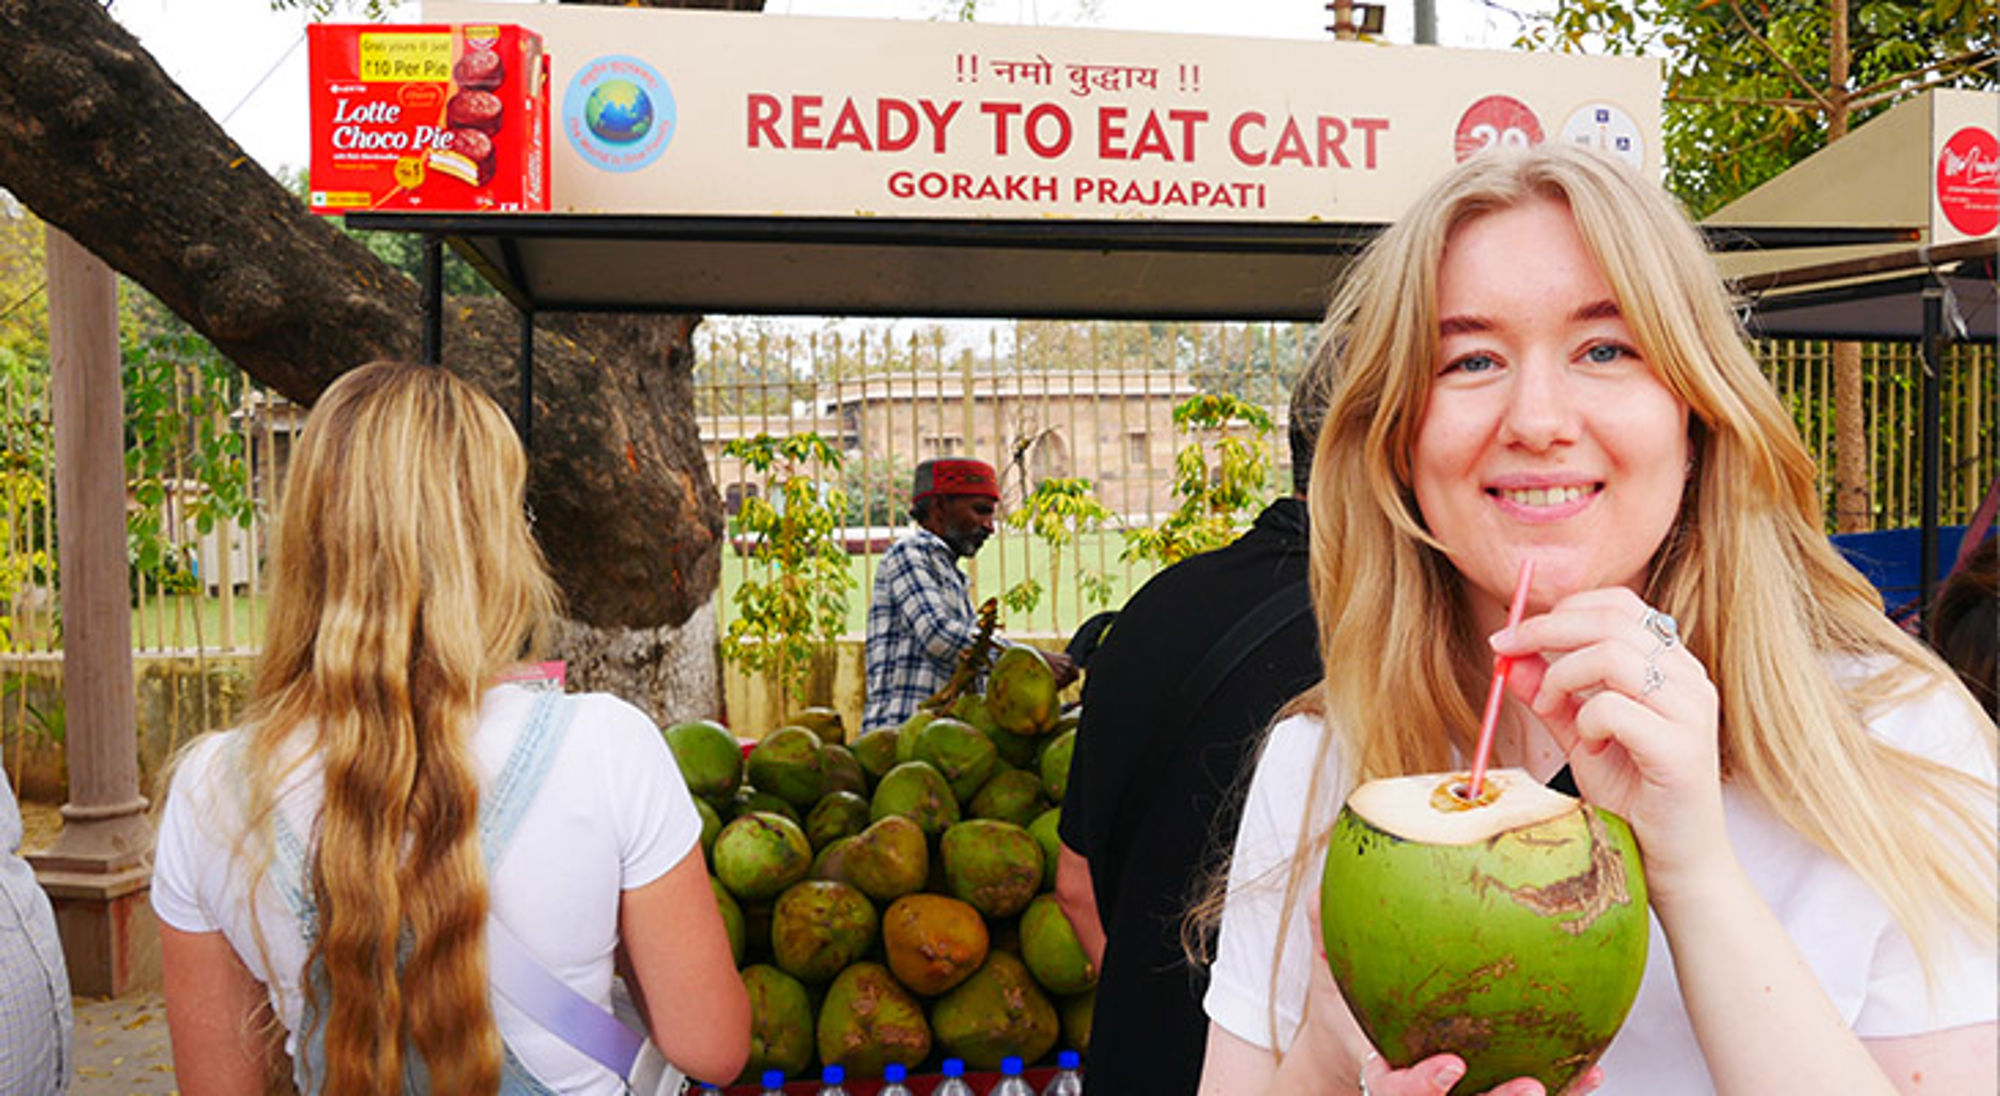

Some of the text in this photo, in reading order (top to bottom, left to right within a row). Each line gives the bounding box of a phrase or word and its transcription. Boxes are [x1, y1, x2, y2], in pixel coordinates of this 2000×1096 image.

[394, 60, 420, 76] Per
[424, 60, 449, 76] Pie
[990, 54, 1053, 85] नमो
[333, 99, 400, 123] Lotte
[332, 126, 454, 150] Choco Pie
[748, 93, 1390, 169] READY TO EAT CART
[888, 171, 1265, 208] GORAKH PRAJAPATI
